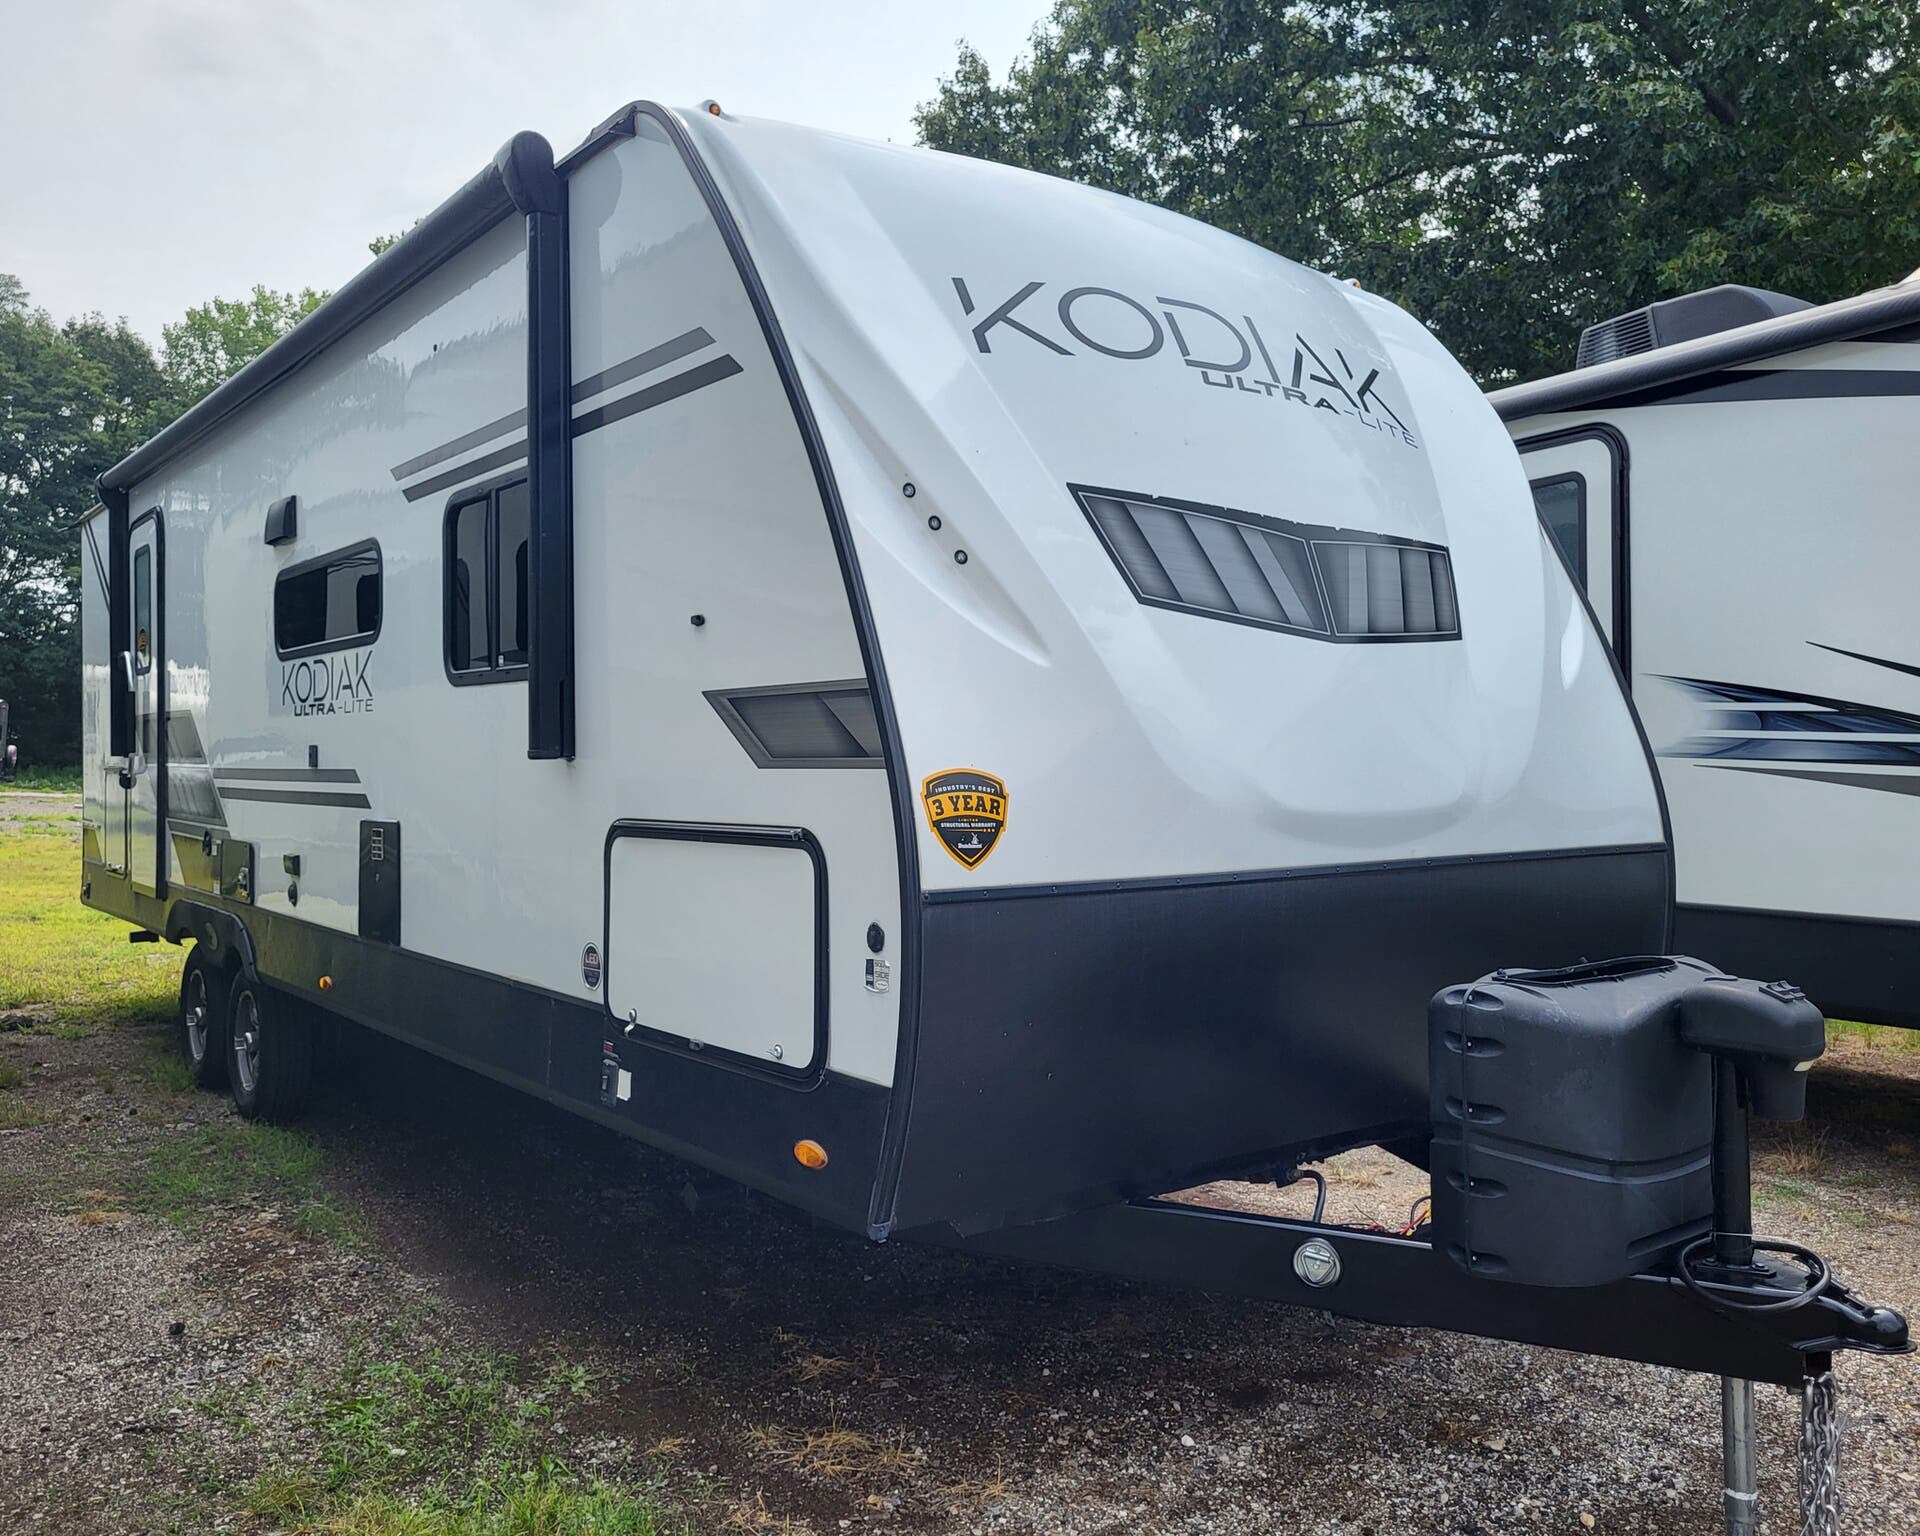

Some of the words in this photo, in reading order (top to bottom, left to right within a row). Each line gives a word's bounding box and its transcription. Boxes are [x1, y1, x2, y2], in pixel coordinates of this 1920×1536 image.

[951, 277, 1408, 432] KODIAK
[1200, 370, 1418, 449] ULTRA-LITE
[282, 650, 373, 706] KODIAK
[294, 698, 374, 717] ULTRA-LITE
[935, 784, 976, 793] INDUSTRY'S
[978, 785, 995, 794] BEST
[932, 799, 945, 816] 3
[948, 795, 1001, 816] YEAR
[585, 952, 599, 964] LED
